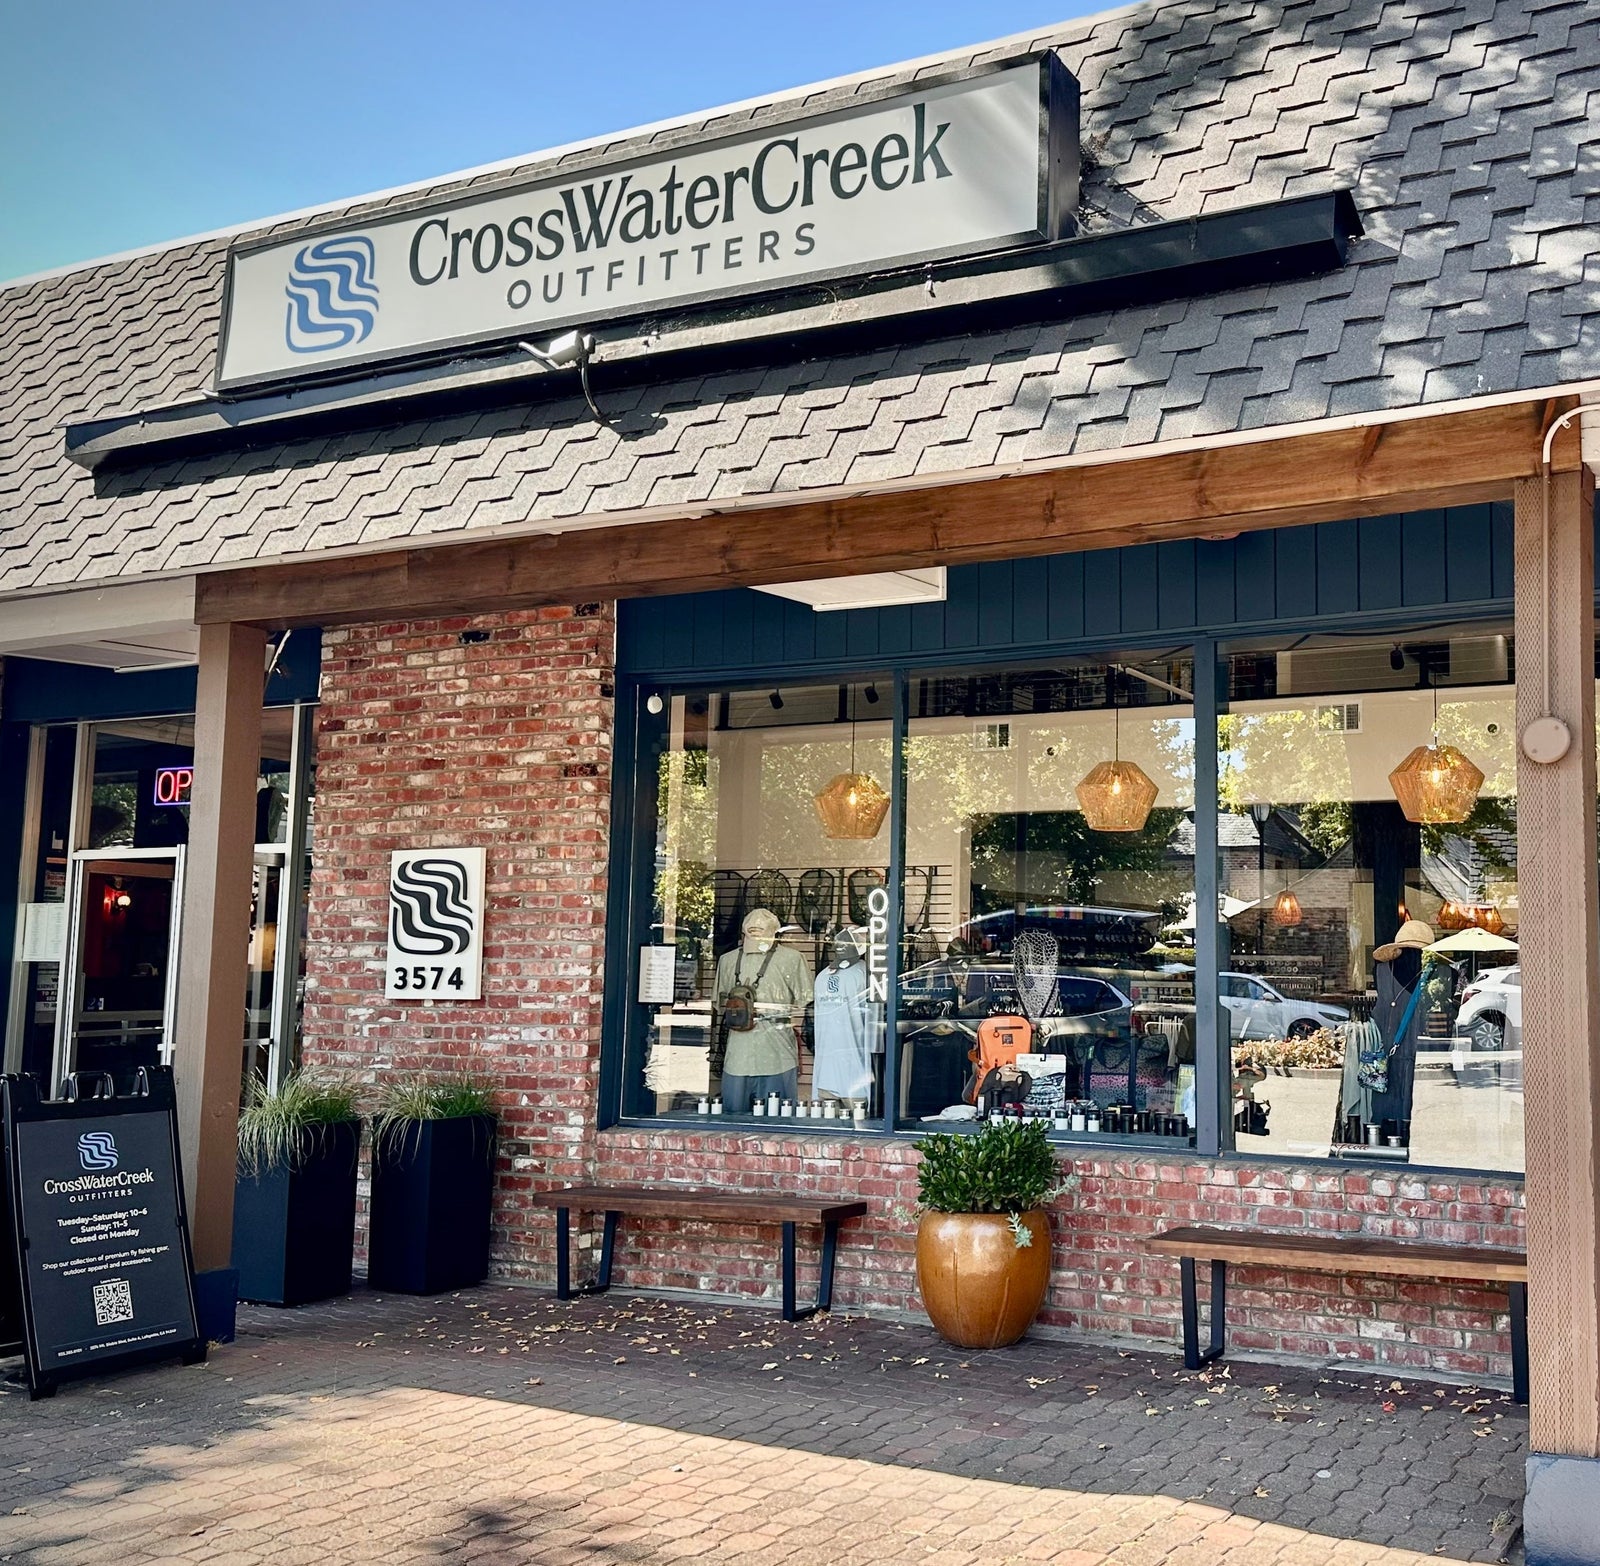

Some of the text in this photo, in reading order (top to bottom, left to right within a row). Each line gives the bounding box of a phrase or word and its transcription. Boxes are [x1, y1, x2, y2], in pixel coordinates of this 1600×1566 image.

[409, 104, 952, 287] CrossWaterCreek
[507, 223, 817, 310] OUTFITTERS
[158, 770, 192, 802] OP
[868, 888, 889, 1002] OPEN
[393, 966, 464, 990] 3574
[44, 1168, 154, 1194] CrossWaterCreek
[69, 1189, 133, 1203] OUTFITTERS
[70, 1233, 97, 1244] Closed
[109, 1228, 140, 1240] Monday
[80, 1223, 112, 1233] Sunday:
[42, 1262, 58, 1271] Shop
[70, 1256, 97, 1265] collection
[104, 1250, 130, 1261] premium
[63, 1267, 86, 1276] outdoor
[87, 1263, 109, 1272] apparel
[109, 1261, 120, 1269] and
